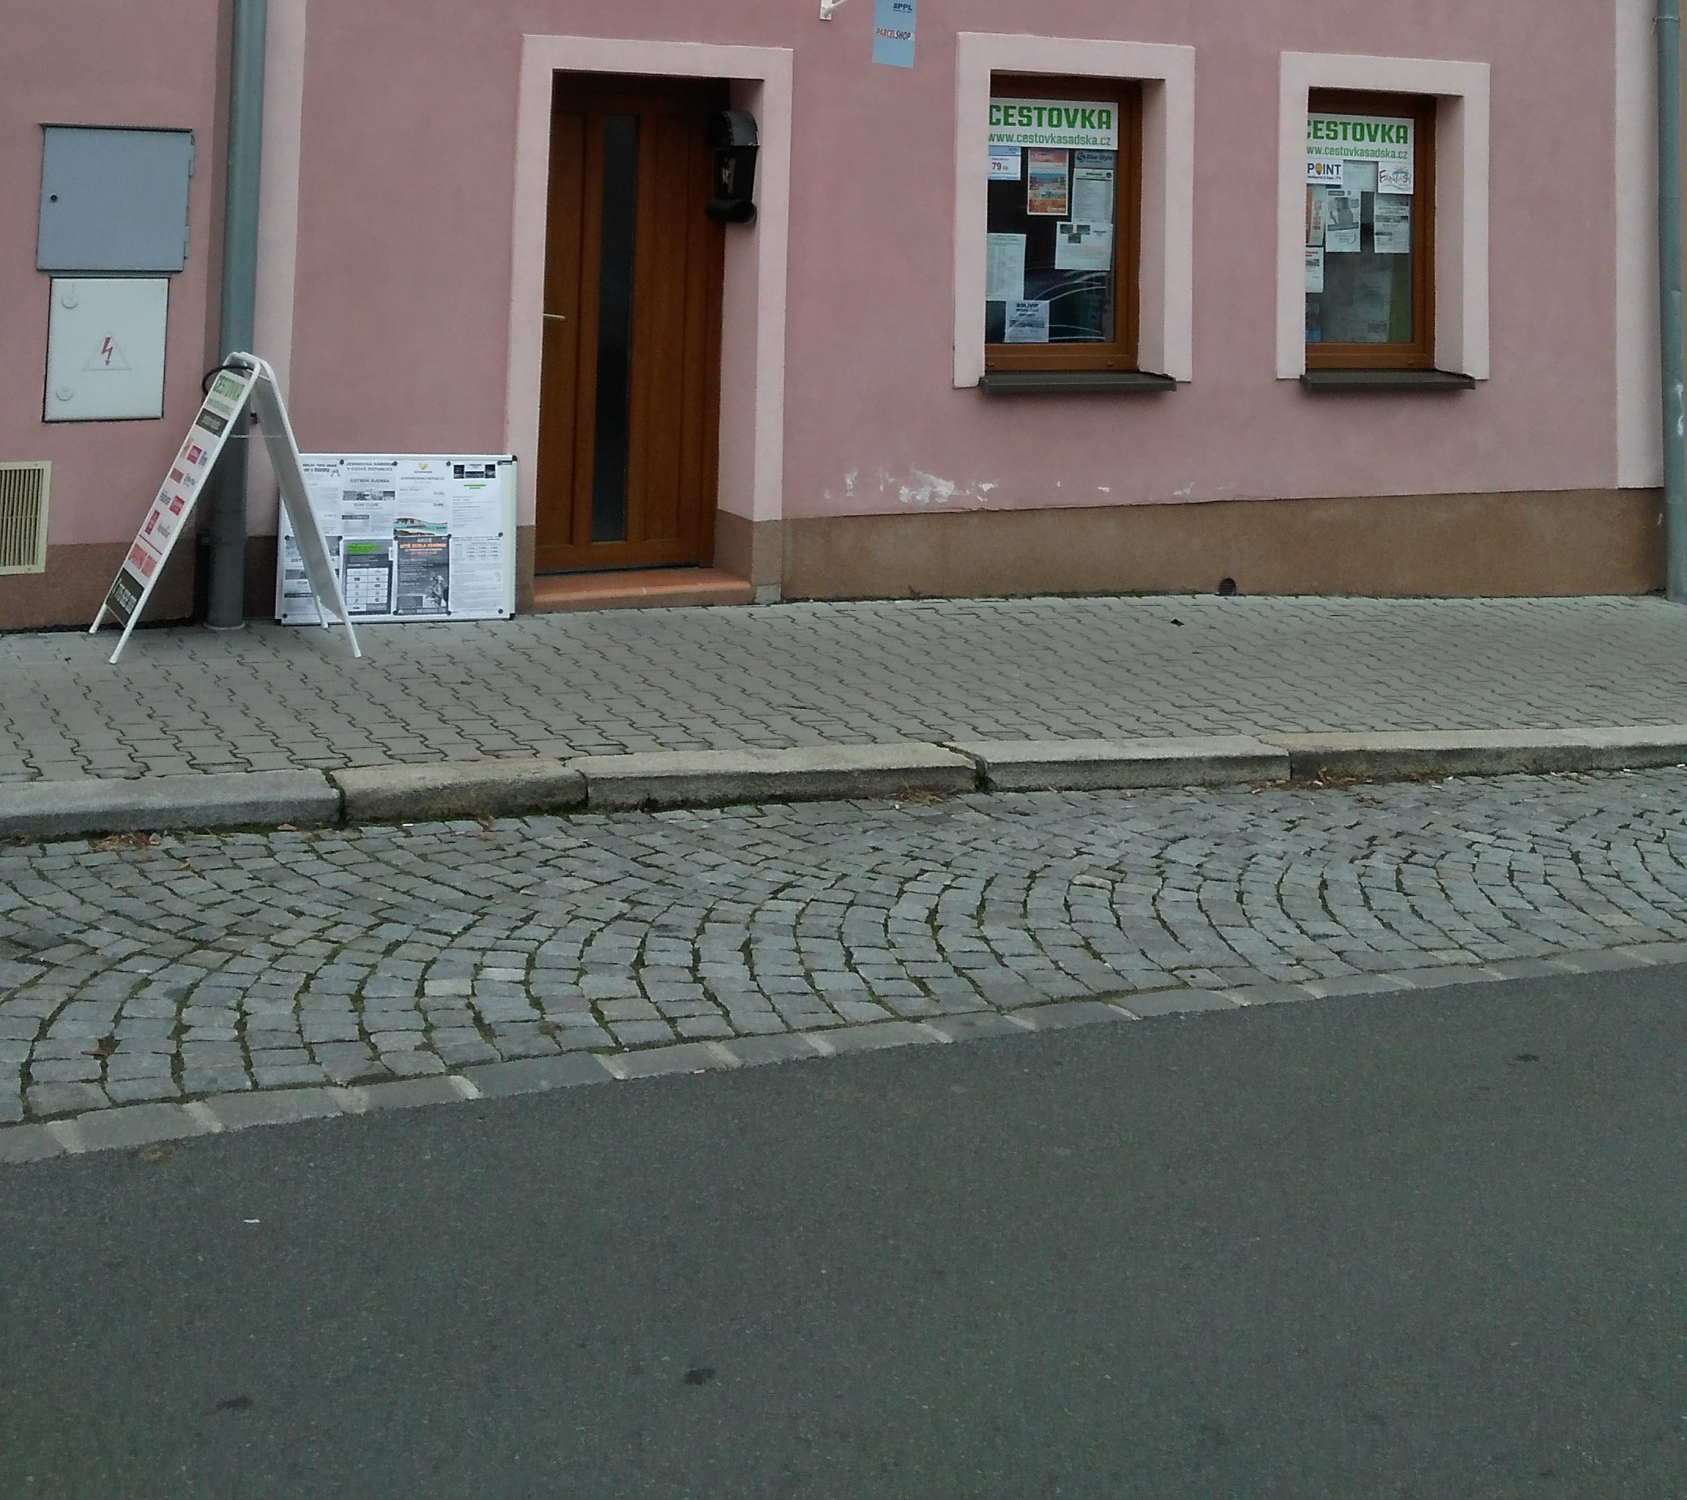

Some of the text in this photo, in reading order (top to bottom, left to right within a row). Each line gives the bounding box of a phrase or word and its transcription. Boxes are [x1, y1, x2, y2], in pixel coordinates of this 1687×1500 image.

[897, 2, 913, 11] PPL
[876, 27, 911, 41] PARCELSHOP
[989, 104, 1111, 130] CESTOVKA
[992, 162, 1002, 171] 79
